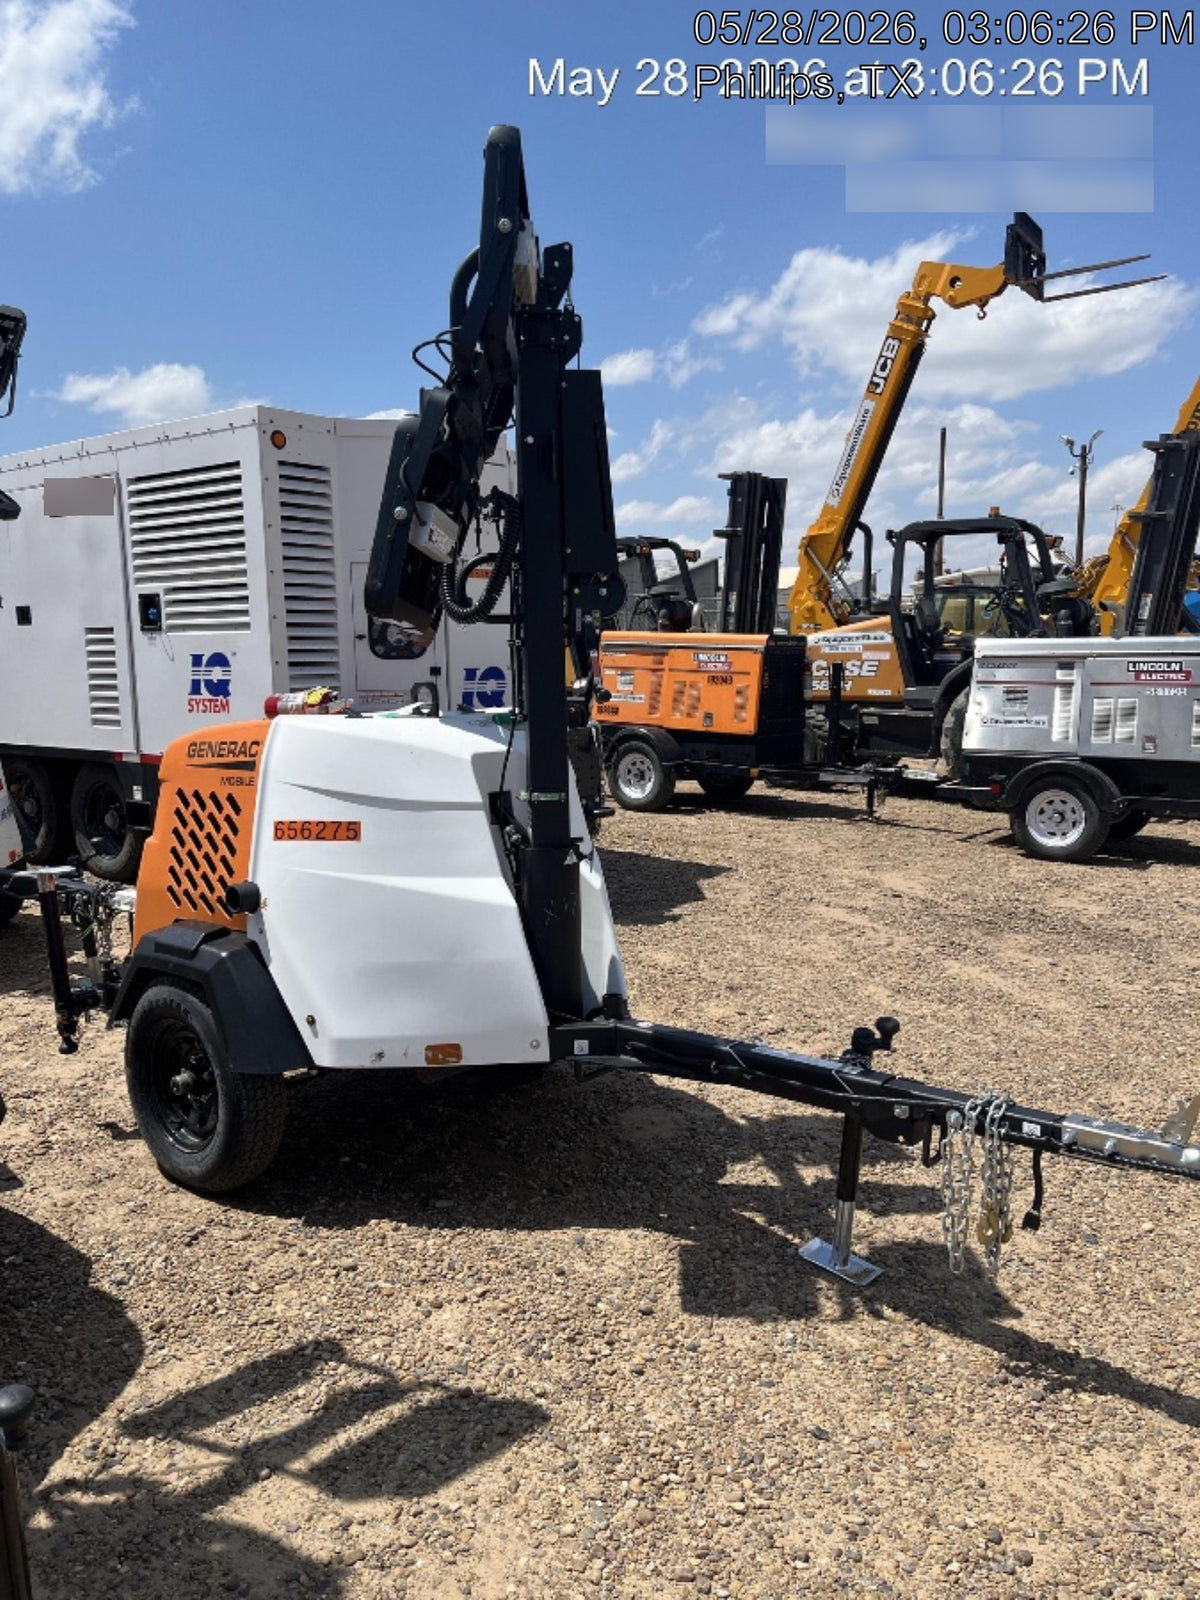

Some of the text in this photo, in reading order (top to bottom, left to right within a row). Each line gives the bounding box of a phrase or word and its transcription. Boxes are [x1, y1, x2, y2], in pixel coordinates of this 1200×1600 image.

[867, 337, 901, 395] JCB
[188, 651, 232, 697] IQ
[812, 660, 879, 676] CSE
[1128, 662, 1181, 671] LINCOLN
[462, 666, 506, 708] IQ
[187, 698, 230, 714] SYSTEM
[187, 741, 260, 758] GENERAC
[220, 777, 255, 786] MOBILE
[274, 821, 359, 840] 656275
